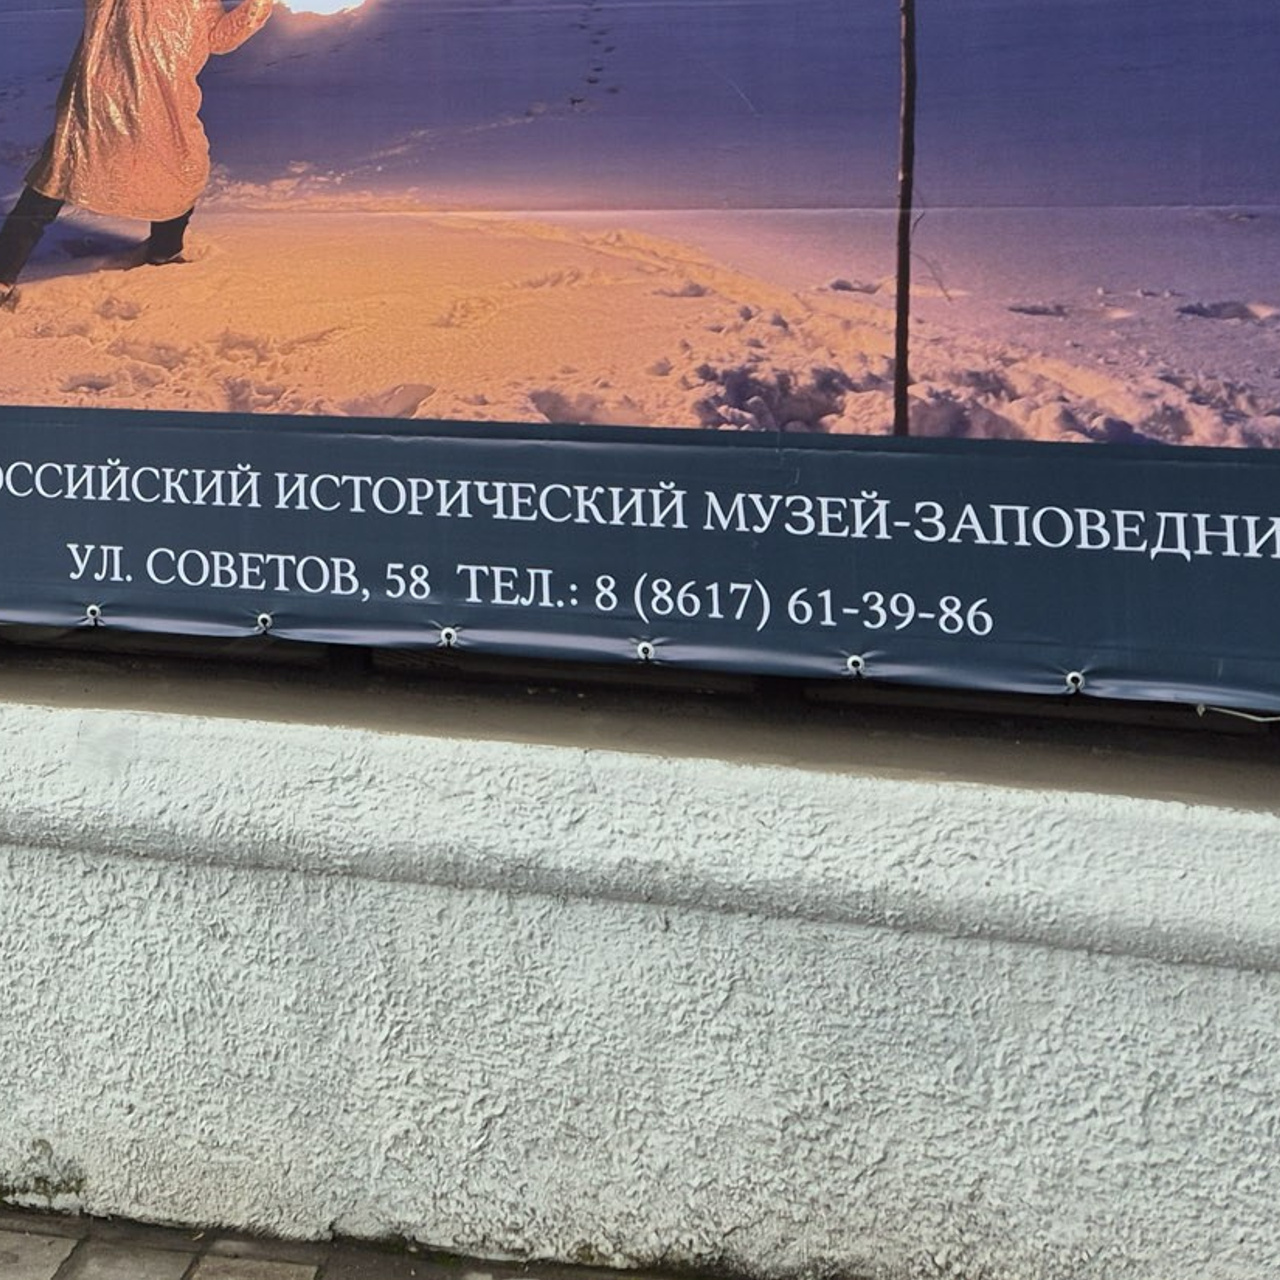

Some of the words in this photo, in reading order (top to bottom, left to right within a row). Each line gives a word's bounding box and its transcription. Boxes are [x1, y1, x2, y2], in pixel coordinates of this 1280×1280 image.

[274, 472, 687, 531] ИСТОРИЧЕСКИЙ
[704, 489, 1280, 562] МУЗЕЙ-ЗАПОВЕДНИ
[67, 543, 132, 583] УЛ.
[146, 548, 370, 602] СОВЕТОВ,
[386, 563, 431, 600] 58
[457, 564, 578, 609] ТЕЛ.:
[594, 575, 618, 612] 8
[634, 572, 771, 632] (8617)
[788, 587, 994, 637] 61-39-86
